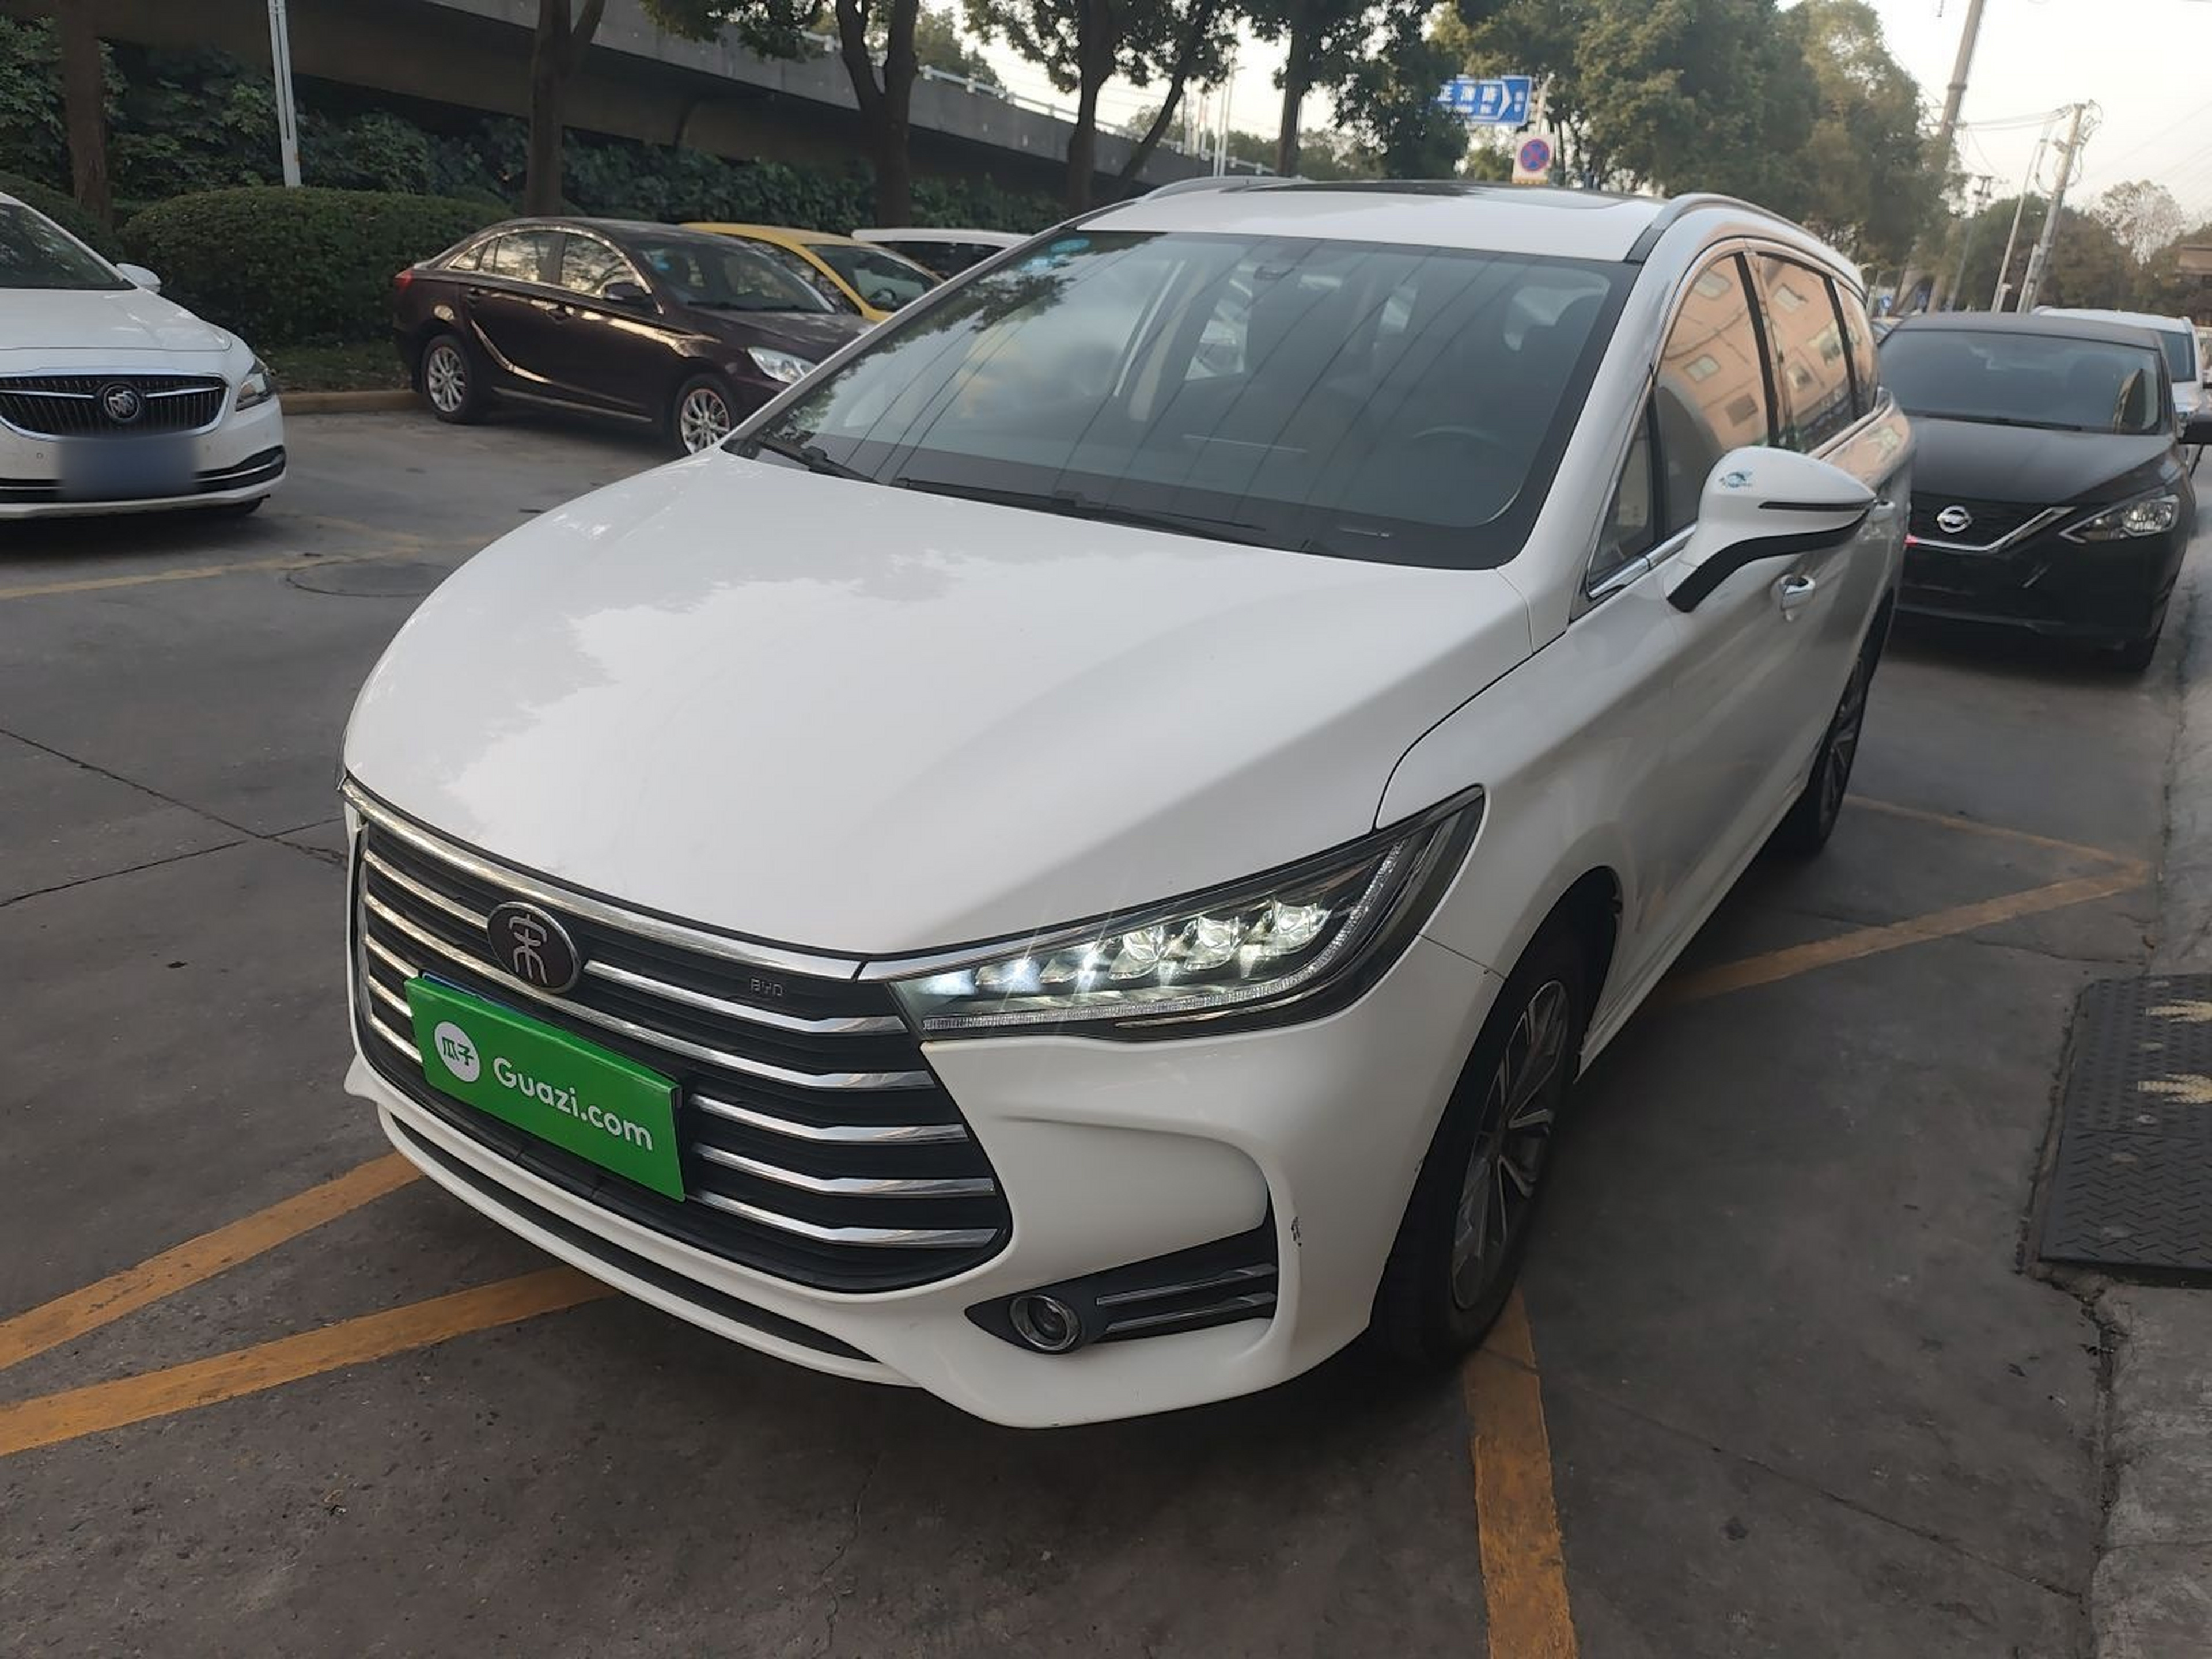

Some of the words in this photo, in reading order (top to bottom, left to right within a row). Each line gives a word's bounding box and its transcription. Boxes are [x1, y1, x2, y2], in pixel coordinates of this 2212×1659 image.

[749, 978, 783, 997] BYD
[442, 1036, 474, 1066] 瓜子
[493, 1057, 653, 1151] Guazi.com
